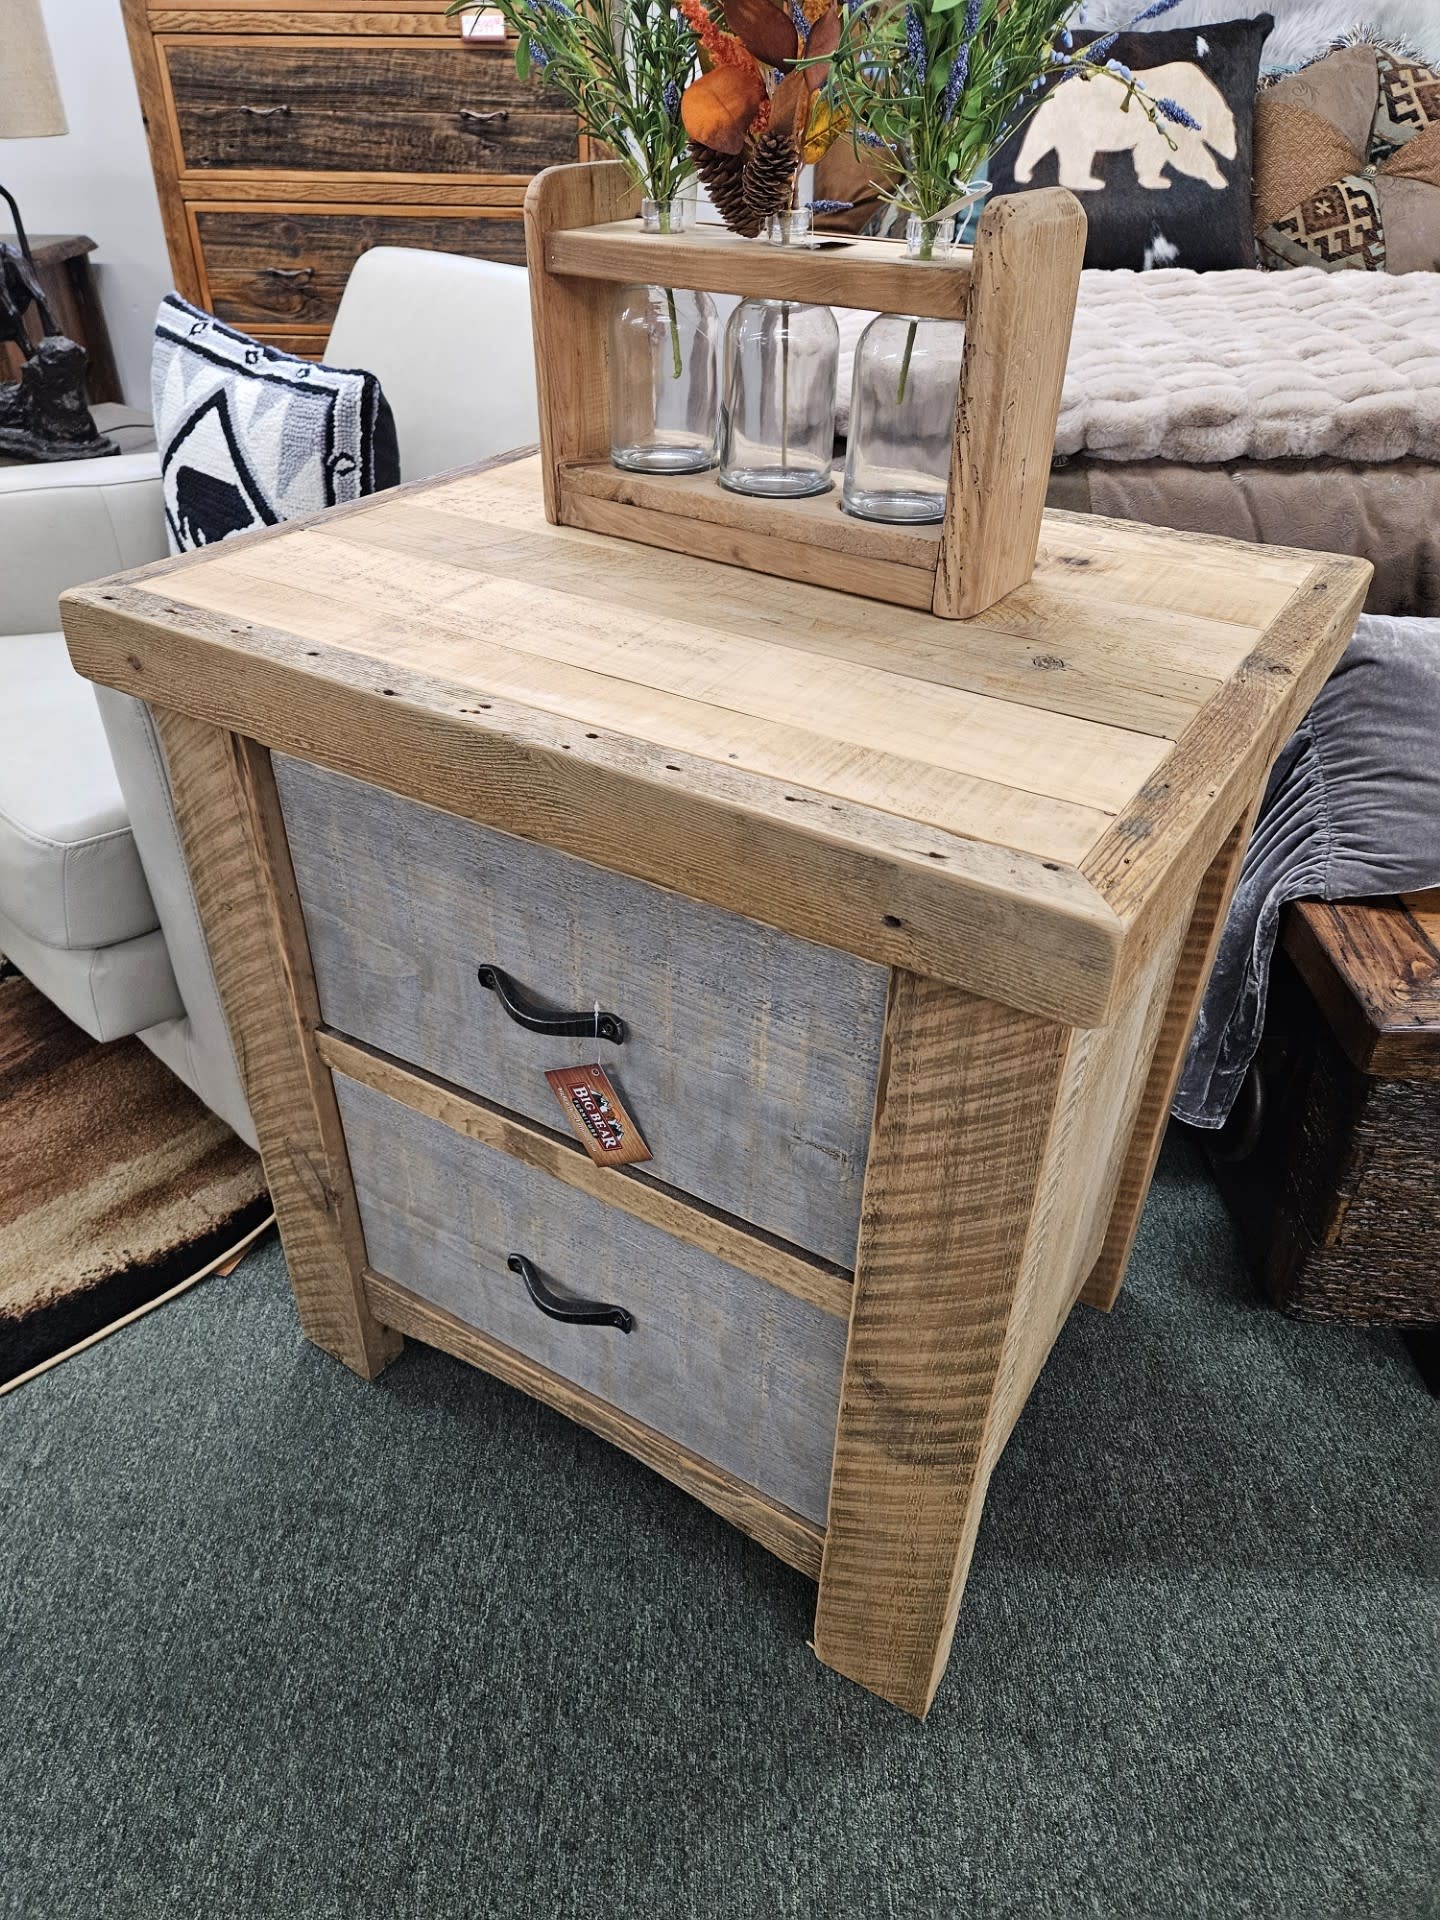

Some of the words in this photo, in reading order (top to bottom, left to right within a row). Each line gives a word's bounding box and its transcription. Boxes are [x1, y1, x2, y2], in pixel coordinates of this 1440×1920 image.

[573, 1086, 594, 1111] BIG
[590, 1112, 617, 1149] BEAR
[573, 1099, 598, 1137] FURNITURE
